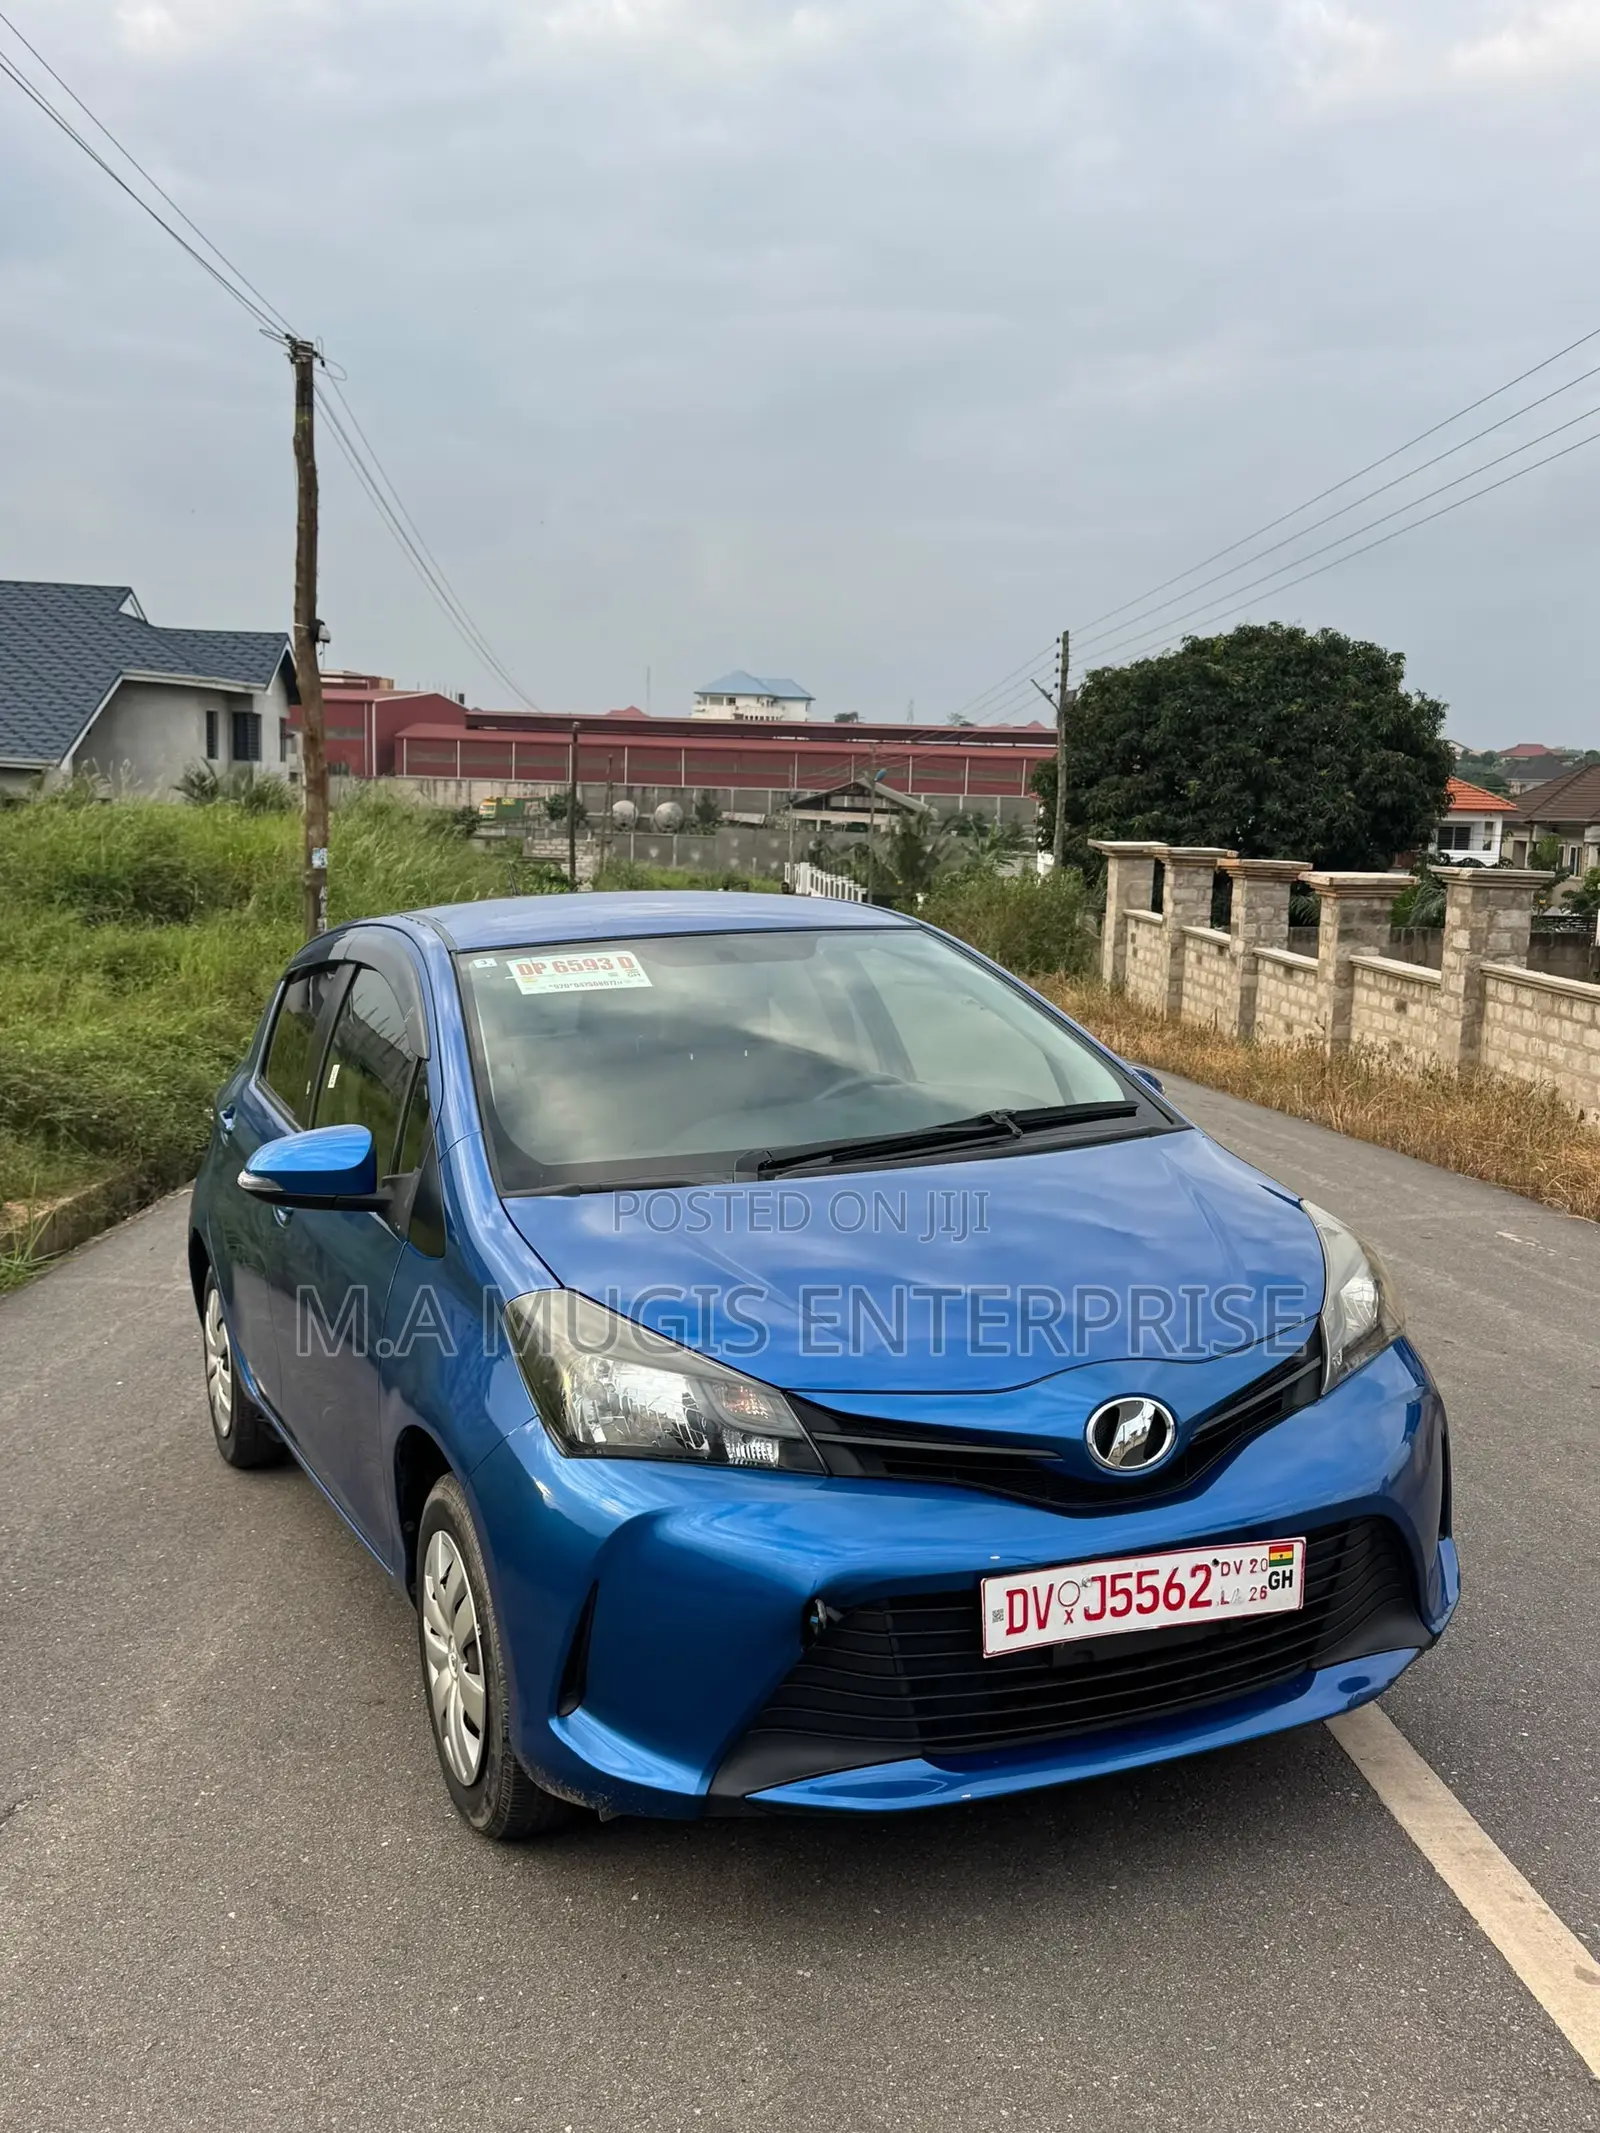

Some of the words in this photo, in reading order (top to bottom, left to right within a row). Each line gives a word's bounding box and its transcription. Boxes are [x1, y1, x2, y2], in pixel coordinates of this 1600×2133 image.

[515, 961, 547, 976] DP
[551, 957, 615, 974] 6593
[616, 956, 635, 969] D
[1220, 1559, 1243, 1577] DV
[1249, 1558, 1268, 1573] 20
[1267, 1569, 1293, 1591] GH
[1006, 1583, 1054, 1636] DV
[1084, 1563, 1213, 1621] J5562
[1248, 1585, 1268, 1602] 26
